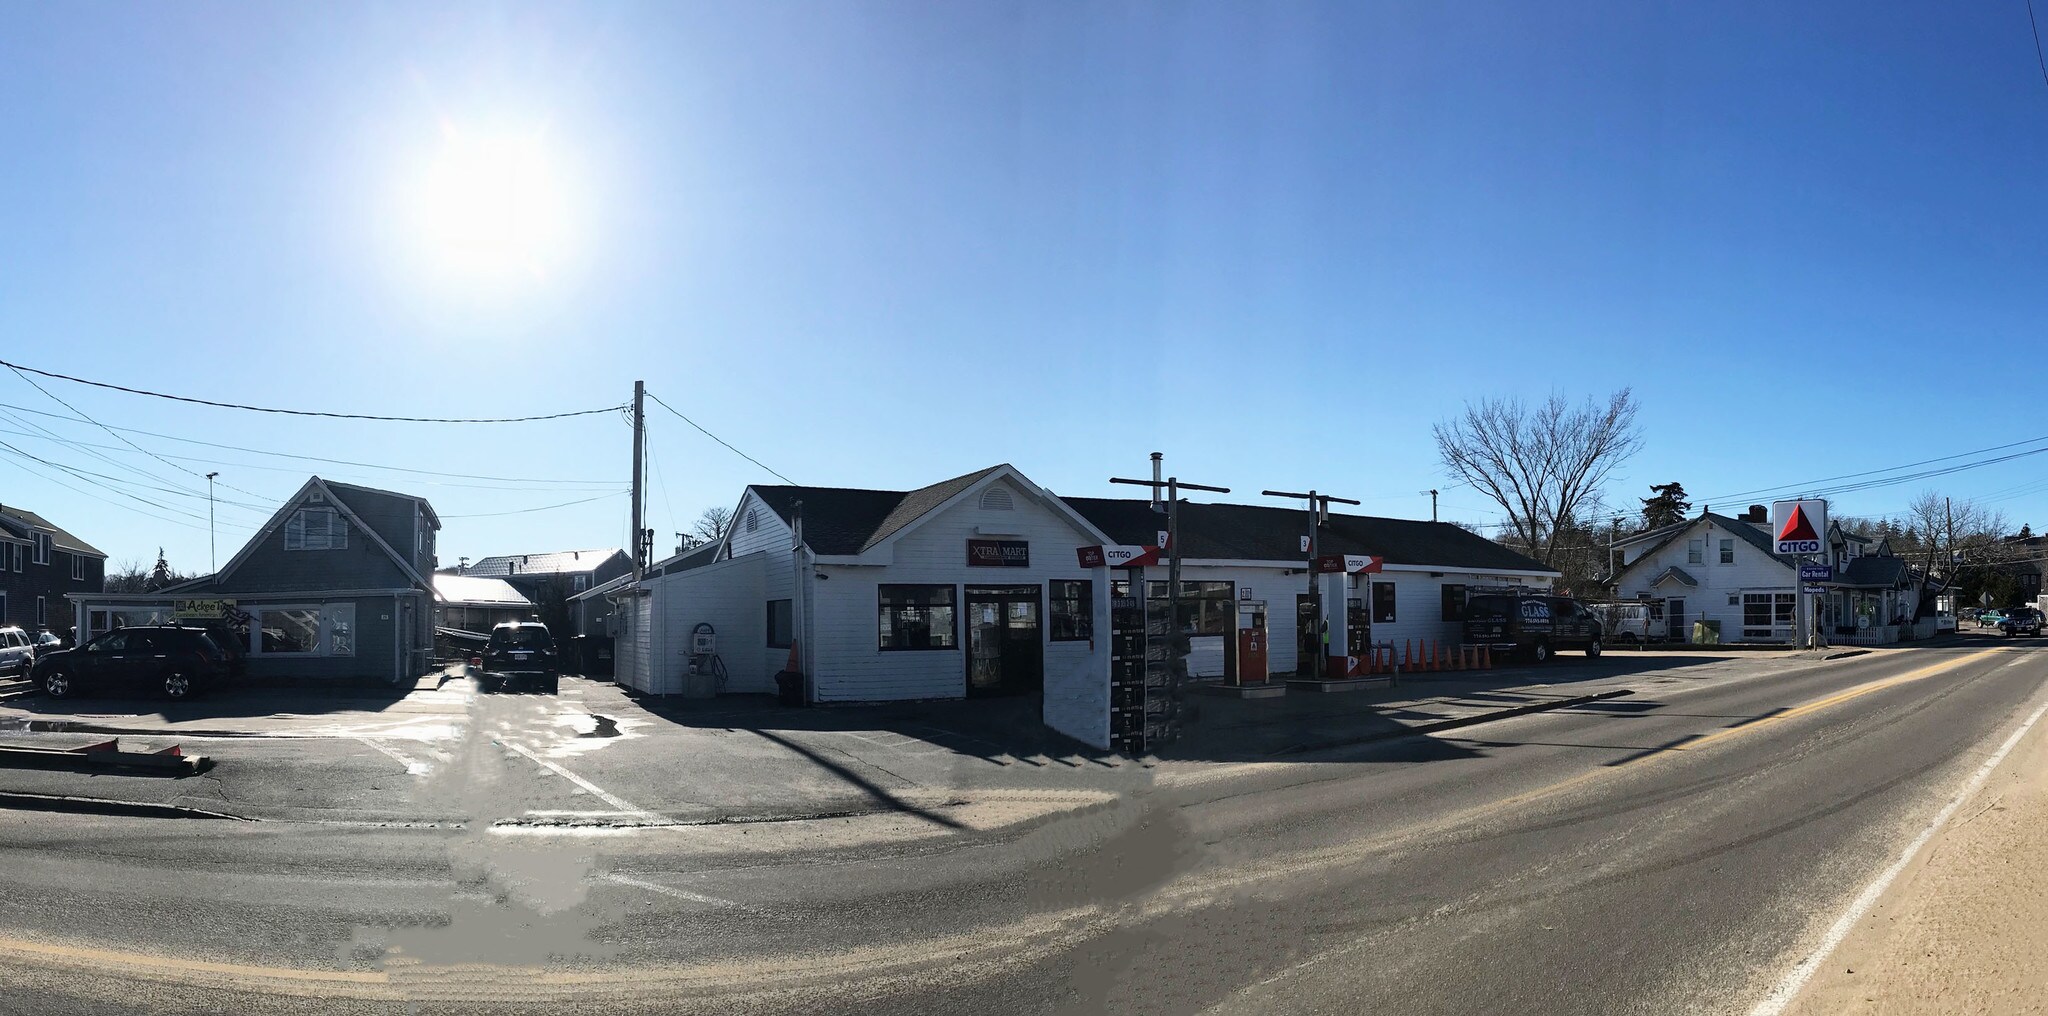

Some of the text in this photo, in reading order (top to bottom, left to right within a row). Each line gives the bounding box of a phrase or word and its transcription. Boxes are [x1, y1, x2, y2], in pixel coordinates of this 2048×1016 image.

[1160, 535, 1165, 543] 5
[973, 546, 1026, 558] XTRA MART
[1779, 541, 1819, 553] CITGO
[1801, 570, 1829, 578] Car Rental
[187, 600, 215, 613] Ackee
[1521, 606, 1550, 618] GLASS
